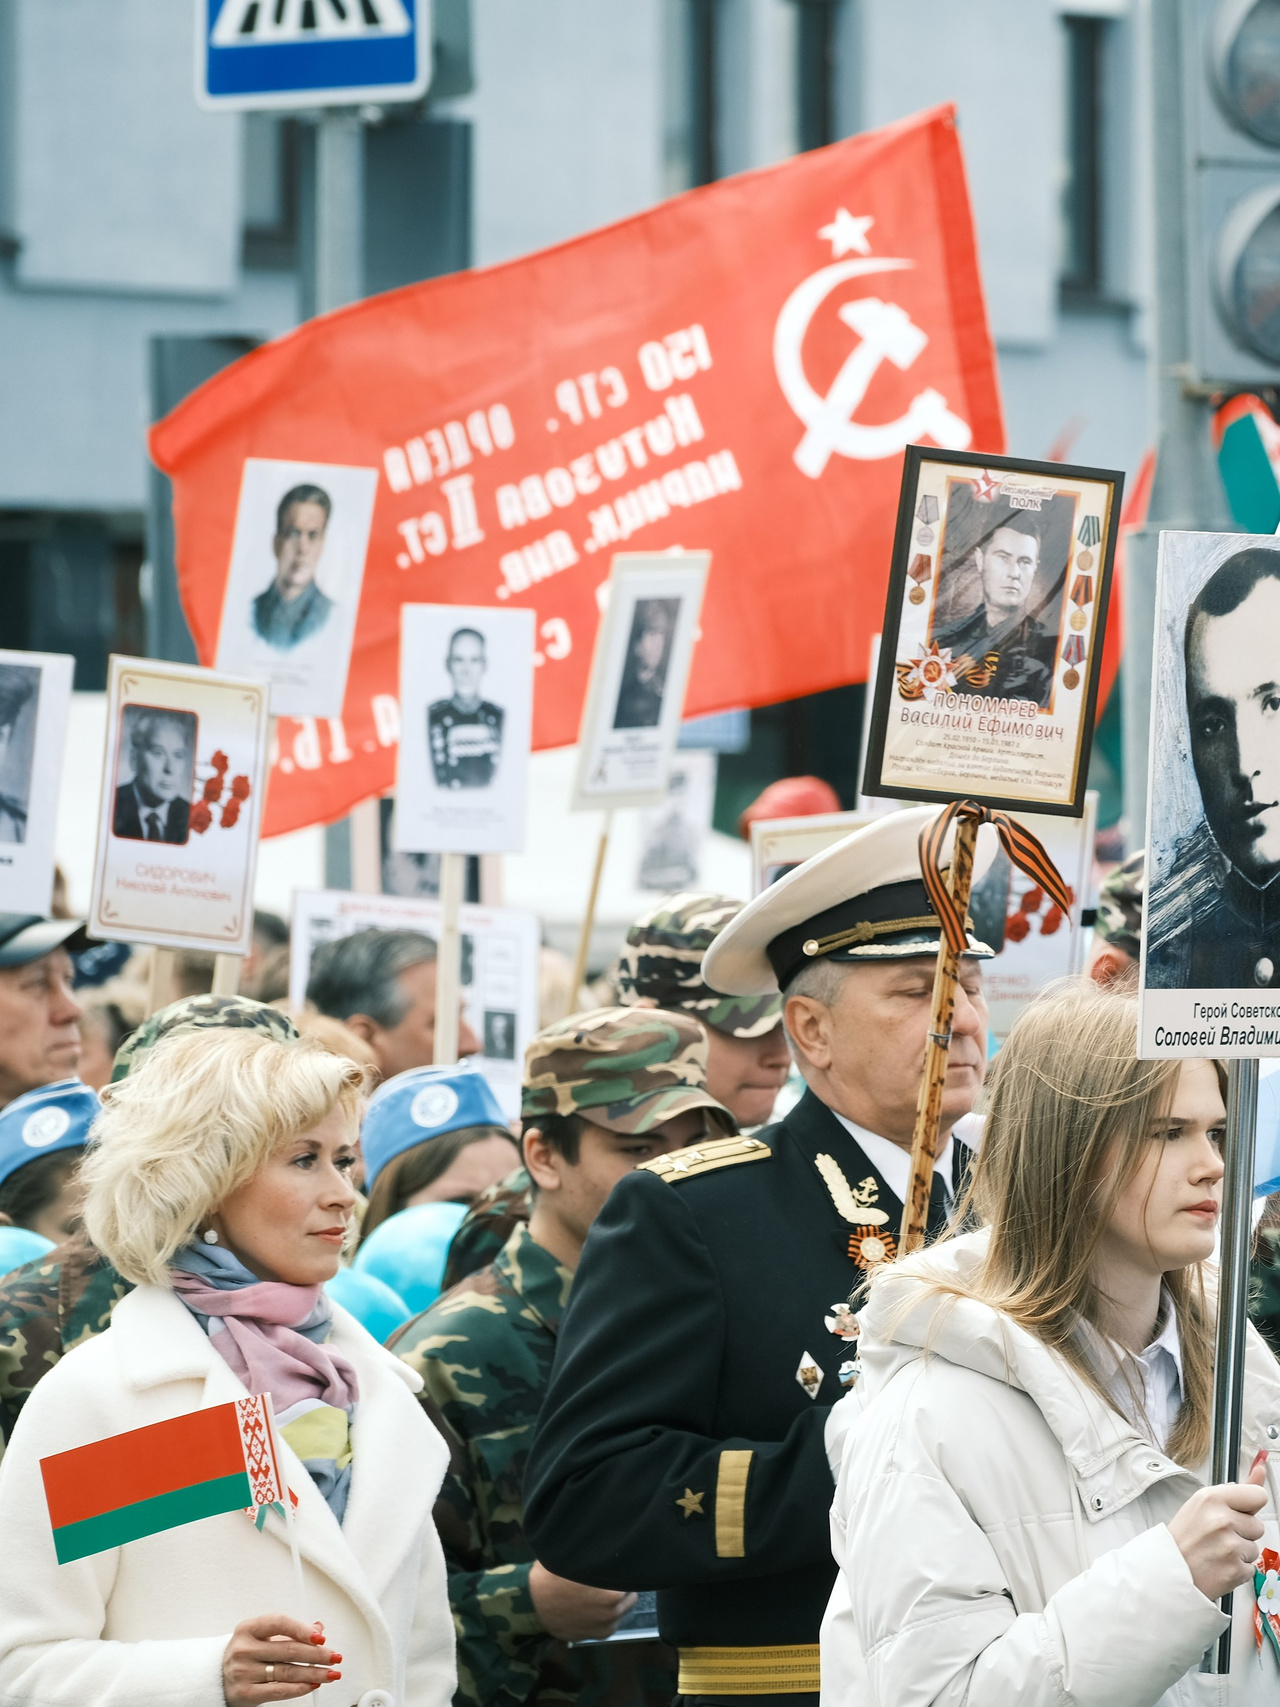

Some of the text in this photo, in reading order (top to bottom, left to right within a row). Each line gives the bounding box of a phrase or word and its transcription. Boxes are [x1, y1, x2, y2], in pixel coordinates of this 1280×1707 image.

[1011, 497, 1041, 509] ПОЛК
[933, 692, 1038, 718] ПОНОМАРЕВ
[901, 707, 1064, 740] Василий Ефимович
[1193, 1002, 1228, 1022] Герой
[1155, 1026, 1216, 1047] Соловей
